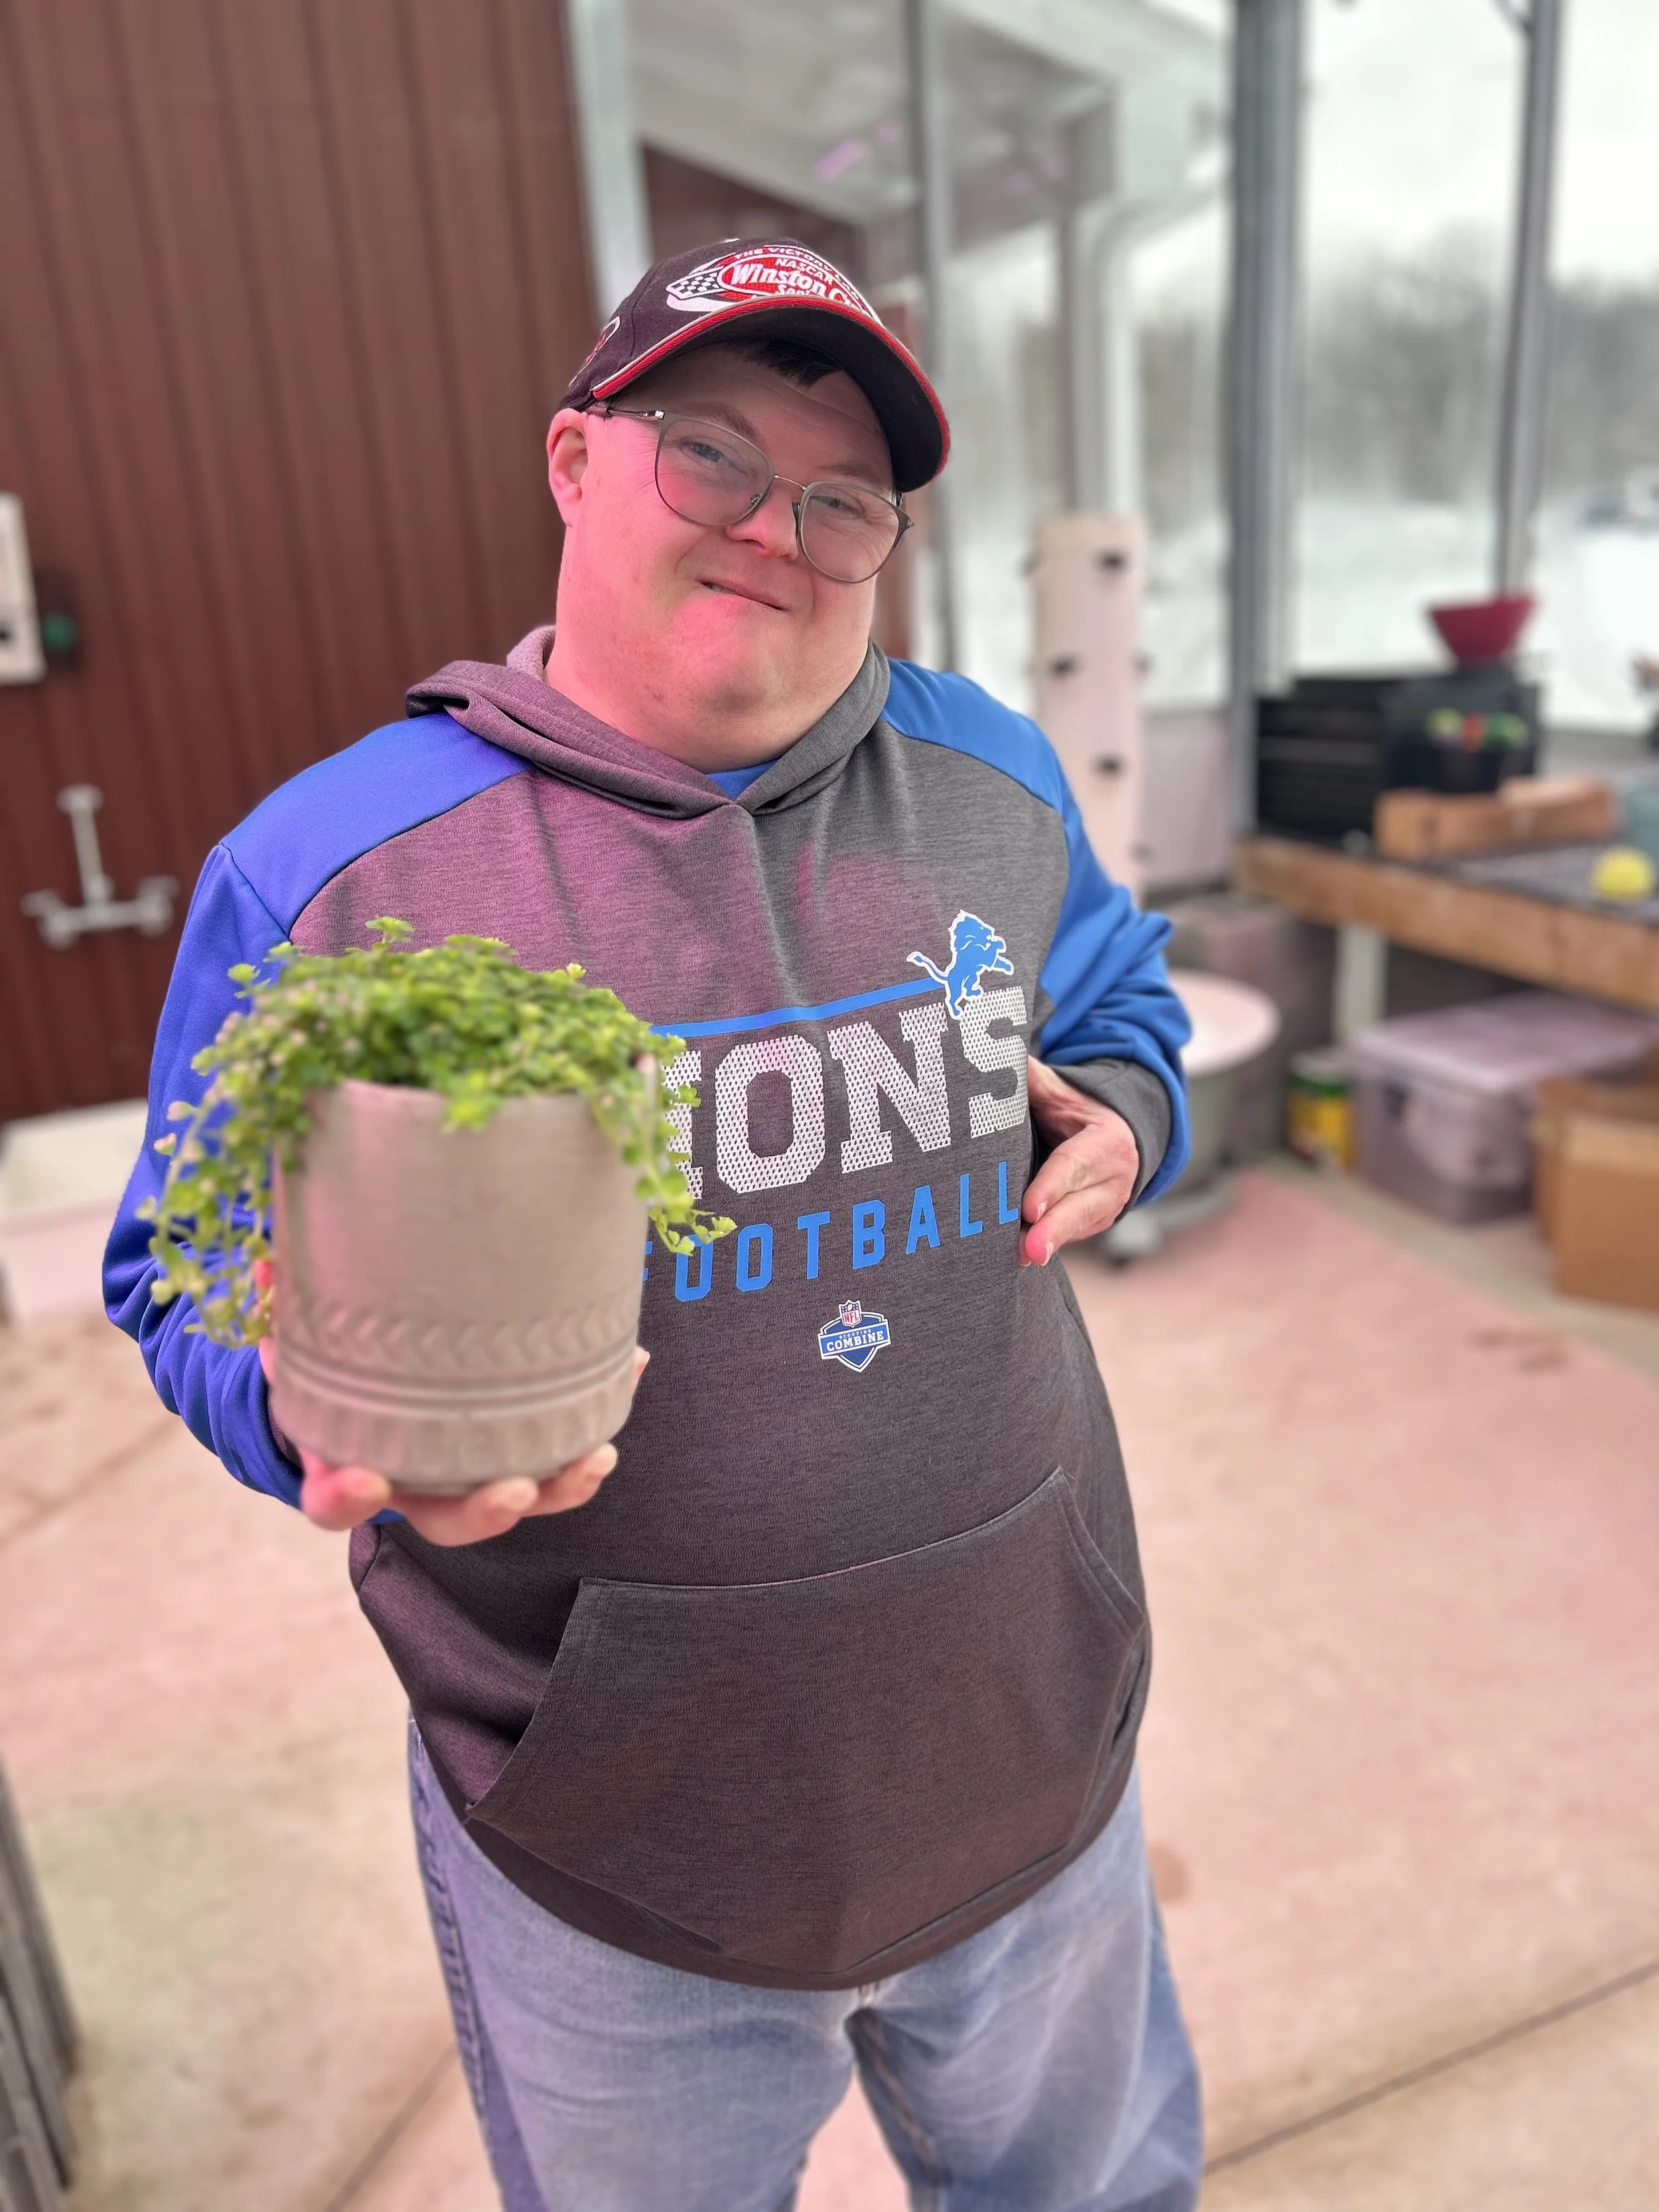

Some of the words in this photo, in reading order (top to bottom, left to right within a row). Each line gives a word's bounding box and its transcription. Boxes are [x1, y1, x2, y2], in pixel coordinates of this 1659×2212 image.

[734, 248, 764, 259] THE
[768, 248, 833, 272] VICTORY
[774, 258, 833, 286] NASCAR
[730, 263, 827, 299] Winston
[660, 986, 1029, 1201] IONS
[642, 1161, 1019, 1303] OOTBALL
[843, 1311, 860, 1324] NFL
[826, 1330, 885, 1352] COMBINE
[839, 1329, 871, 1339] SCOUTING
